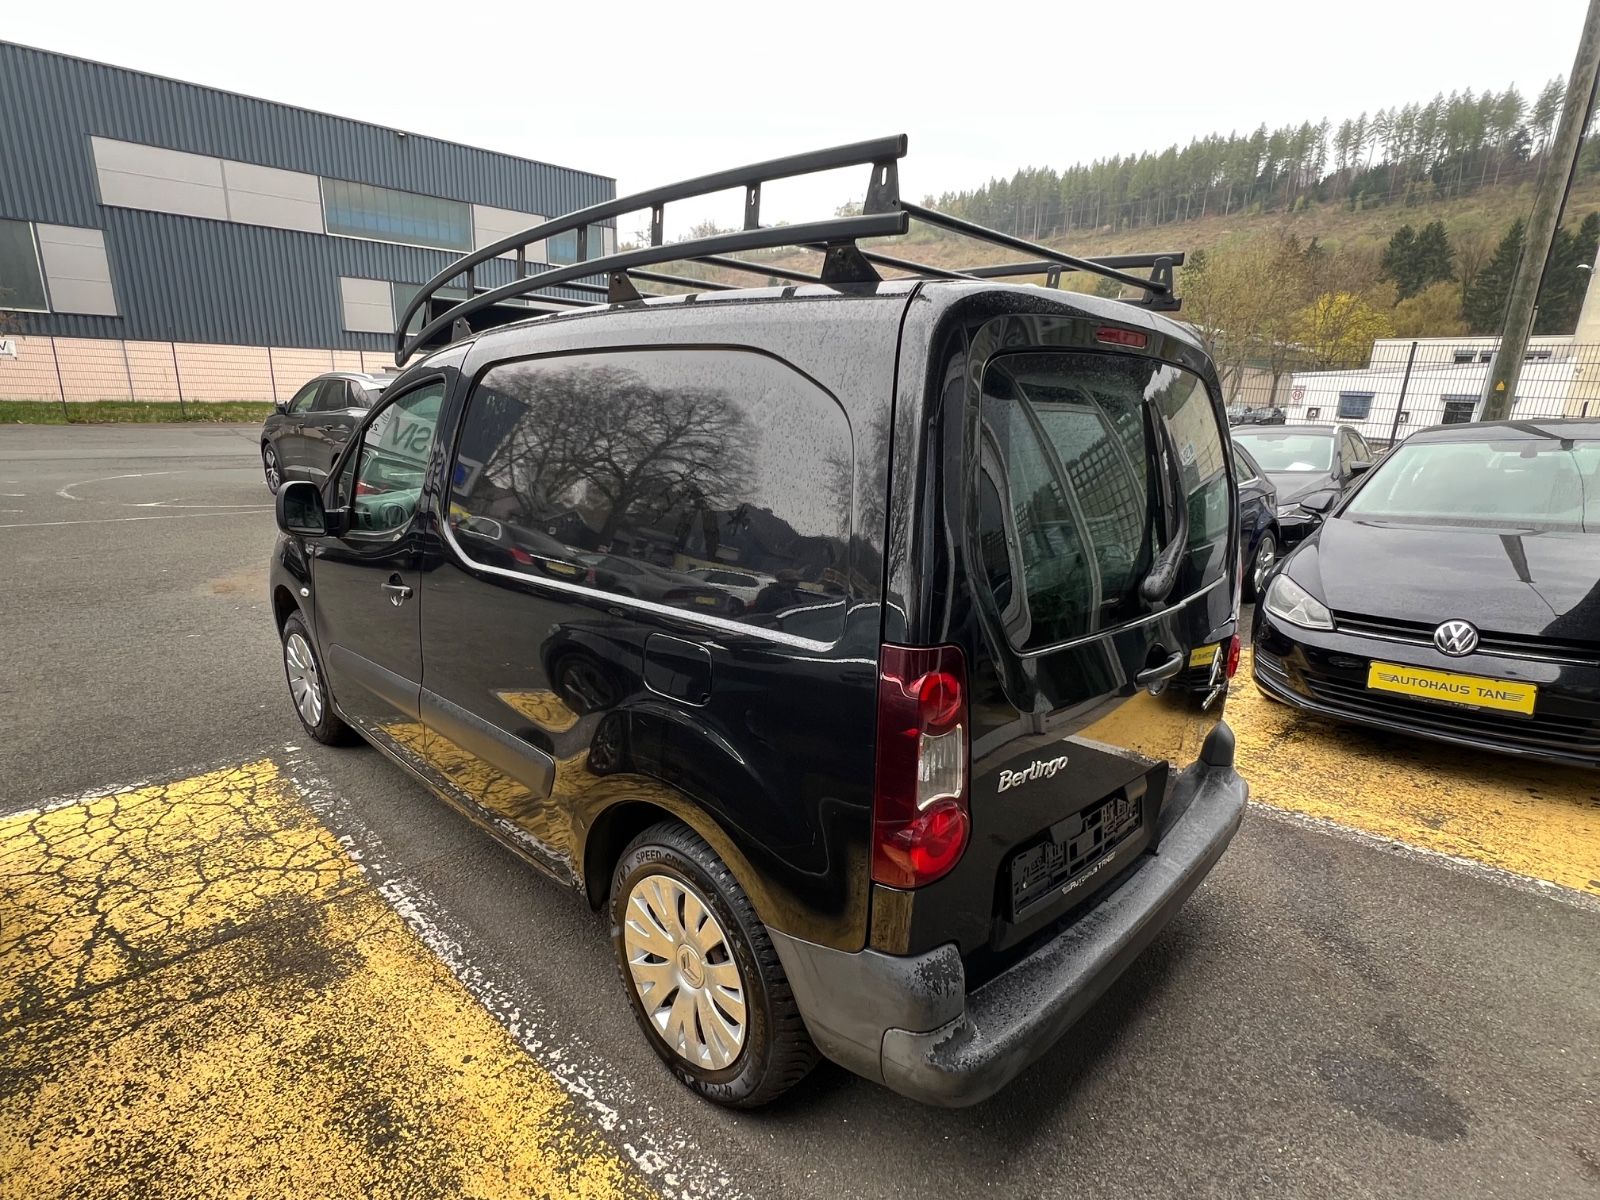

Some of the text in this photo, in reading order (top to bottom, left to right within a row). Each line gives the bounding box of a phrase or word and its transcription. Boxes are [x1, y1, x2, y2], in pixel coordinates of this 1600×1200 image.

[1391, 674, 1507, 700] AUTOHAUS TAN
[998, 756, 1069, 793] Berlingo
